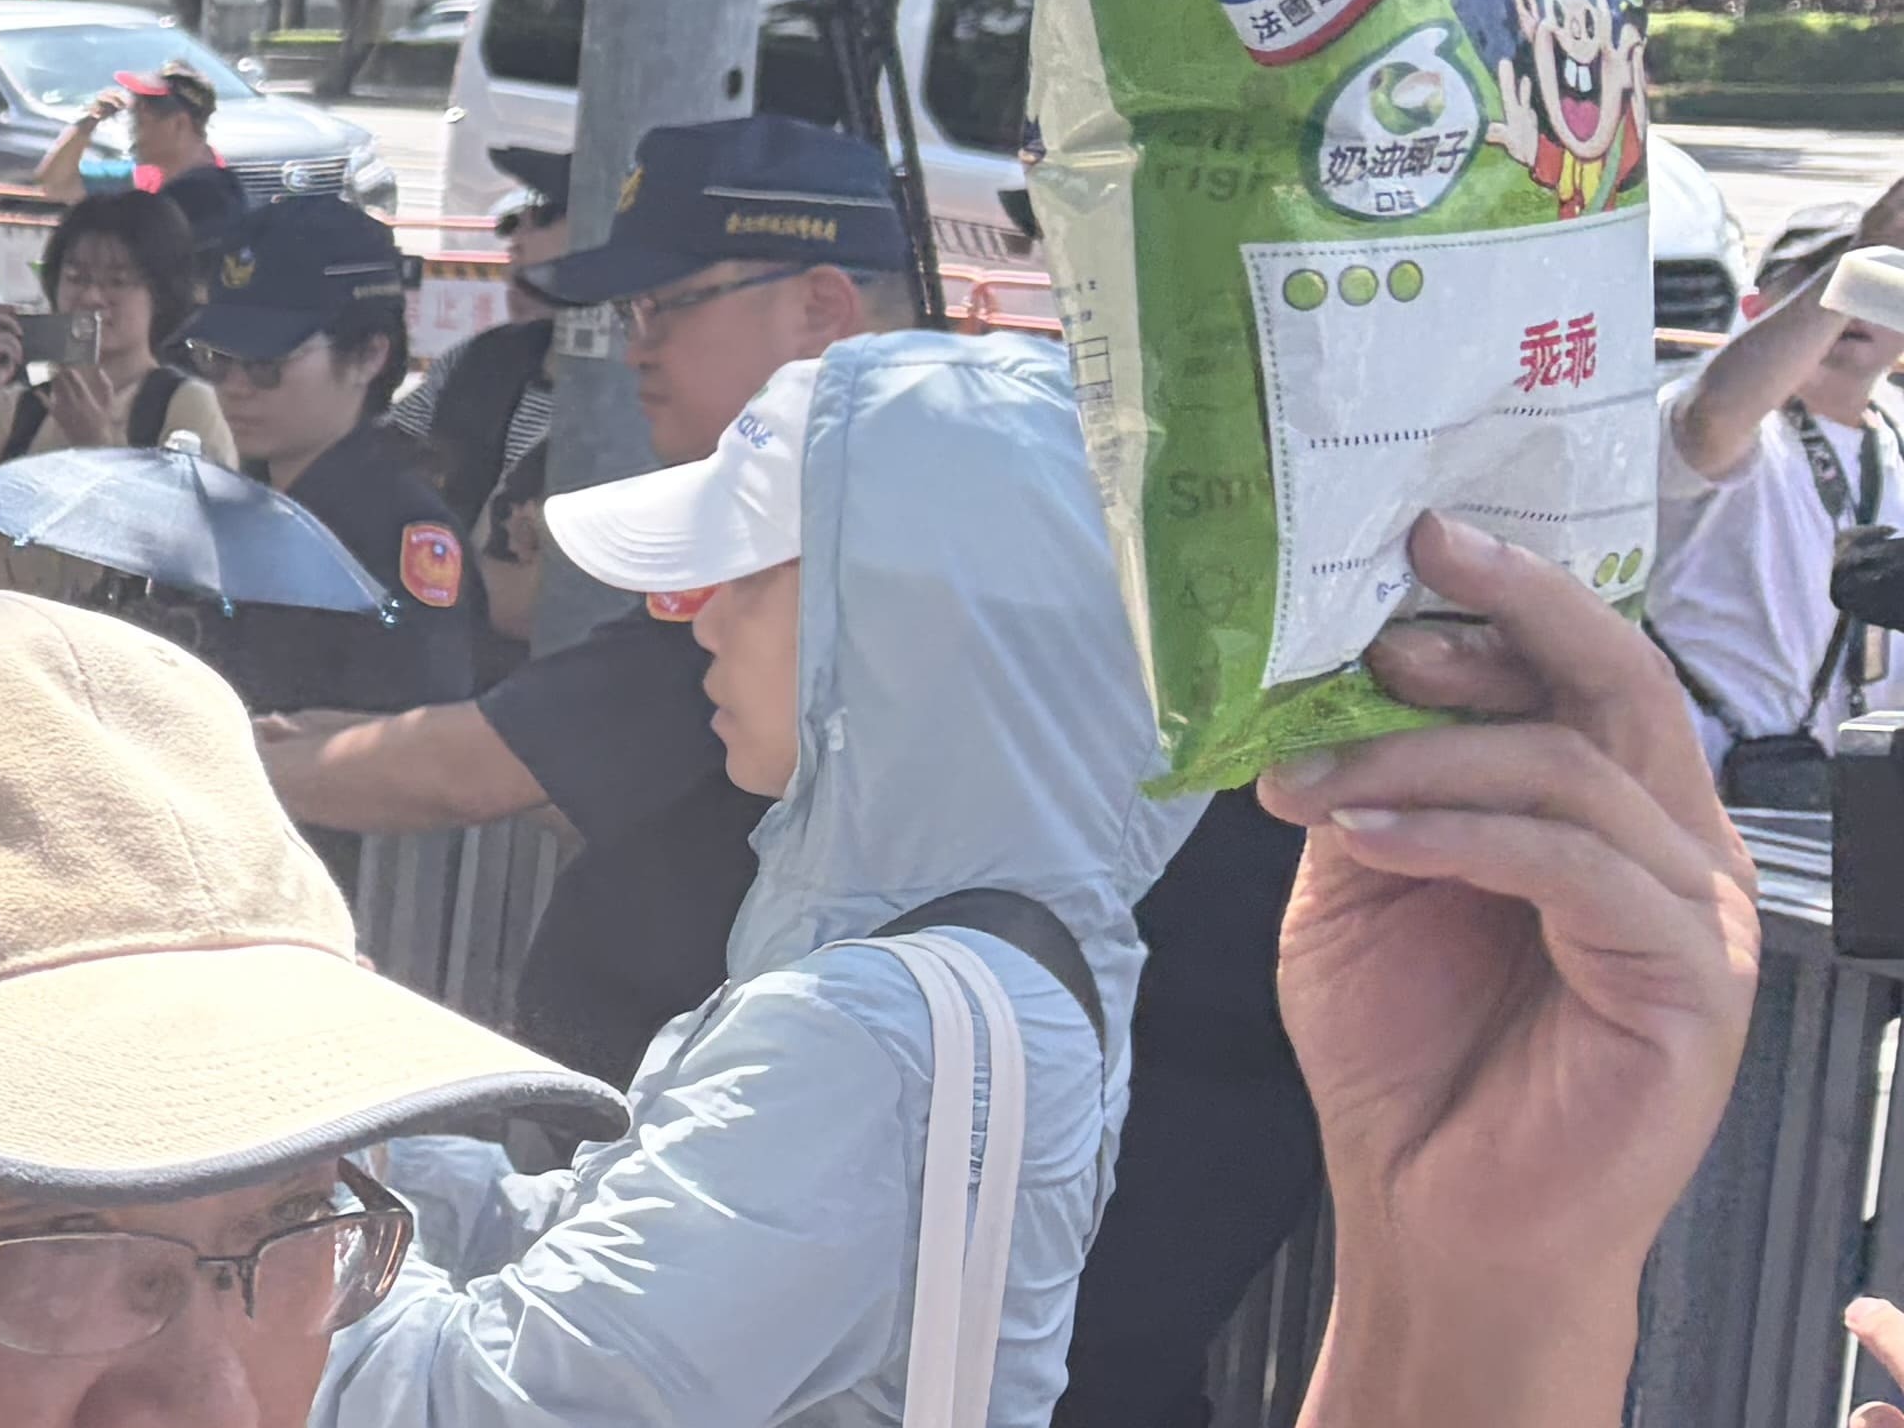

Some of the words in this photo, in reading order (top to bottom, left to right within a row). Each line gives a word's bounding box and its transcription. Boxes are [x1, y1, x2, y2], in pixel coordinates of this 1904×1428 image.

[1321, 129, 1469, 186] 奶油椰子
[1509, 312, 1598, 393] 乖乖
